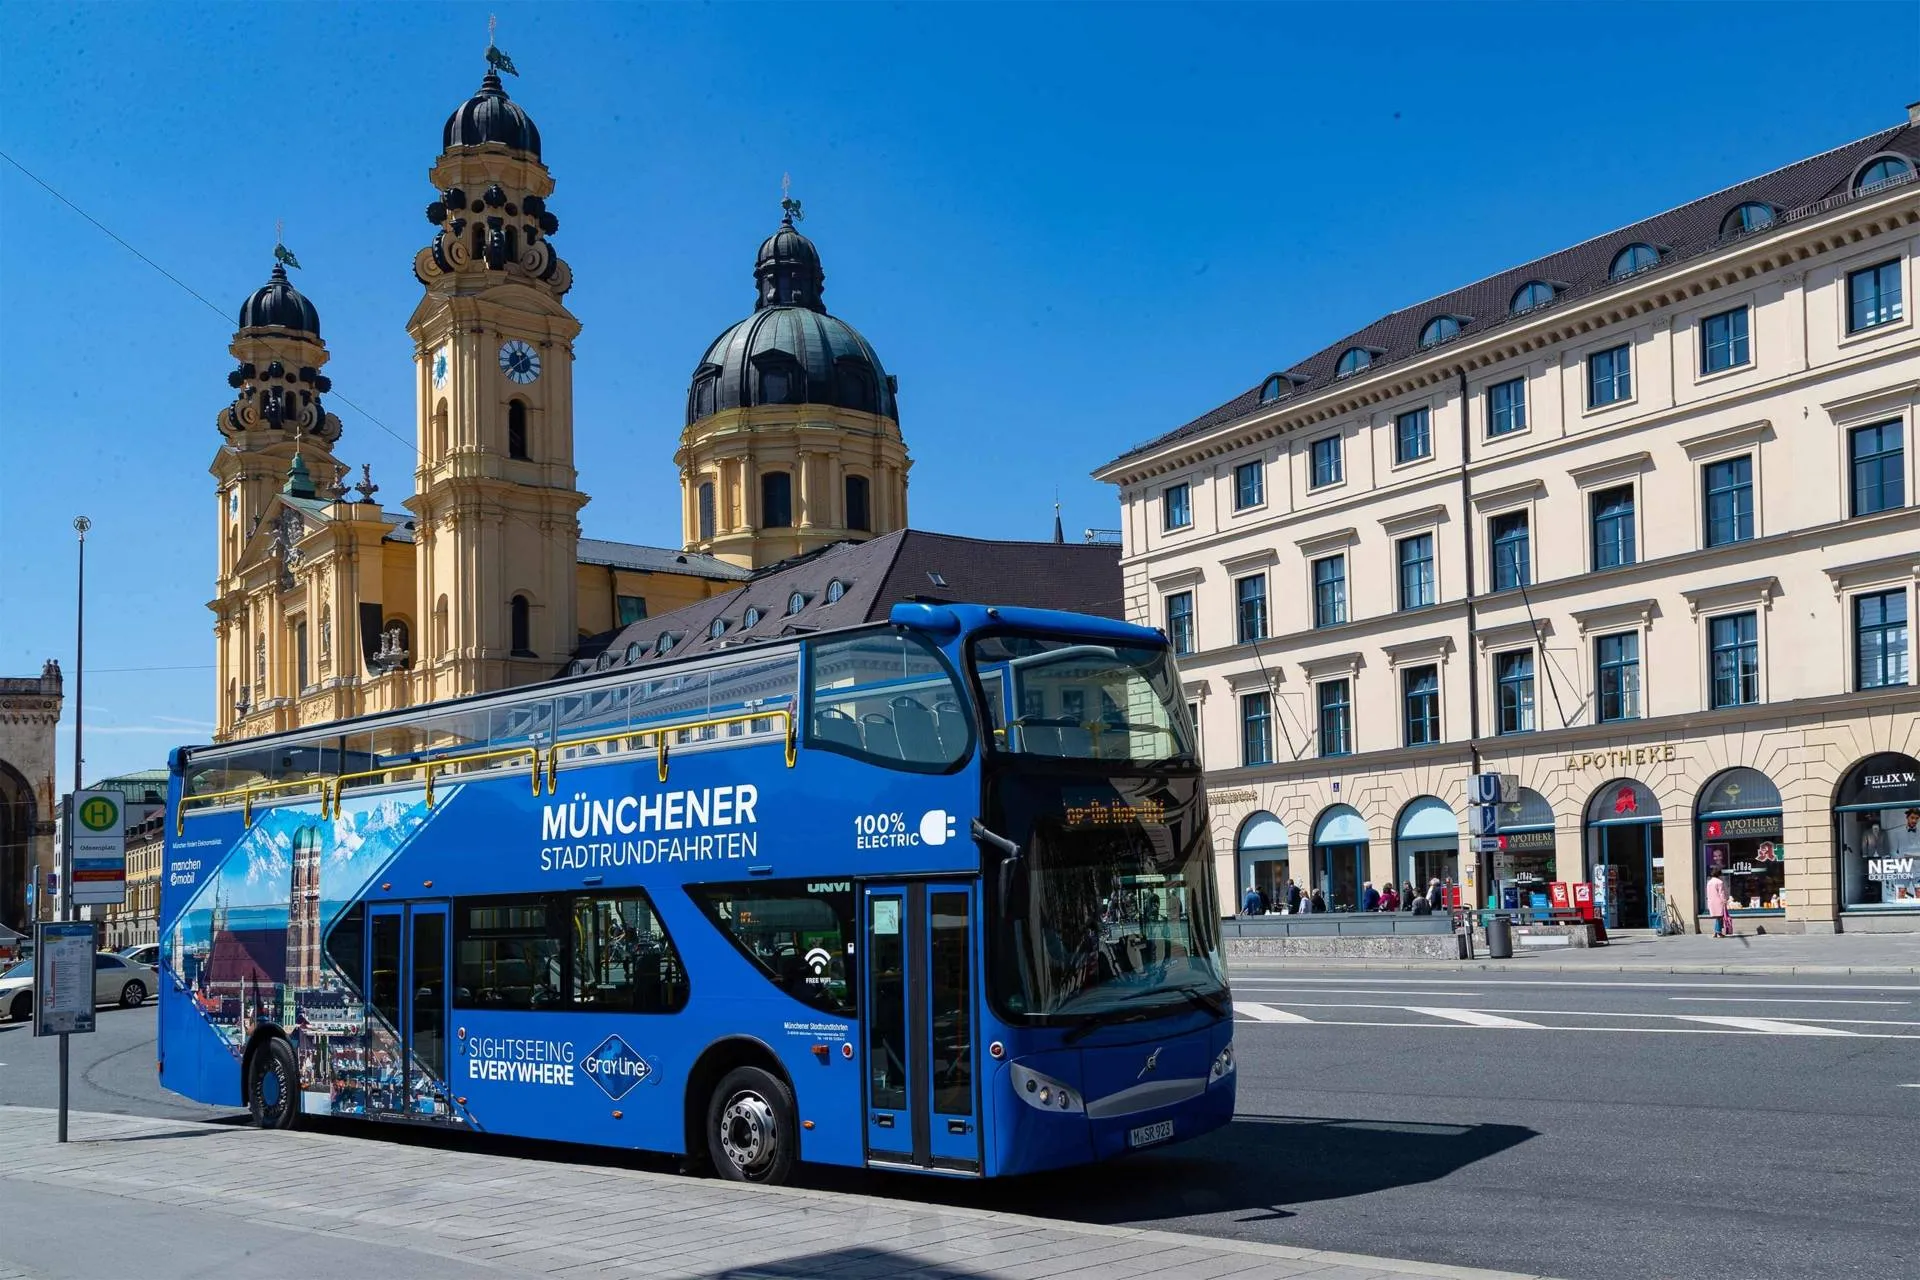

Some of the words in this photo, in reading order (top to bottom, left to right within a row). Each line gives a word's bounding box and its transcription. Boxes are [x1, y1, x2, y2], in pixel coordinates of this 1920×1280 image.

[1567, 744, 1676, 772] APOTHEKE
[1480, 775, 1496, 801] U
[1864, 773, 1900, 786] FELIX
[1902, 772, 1916, 782] W.
[90, 803, 108, 824] H
[541, 784, 759, 841] MÜNCHENER
[854, 812, 906, 835] 100%
[1724, 817, 1779, 830] APOTHEKE
[857, 832, 920, 849] ELECTRIC
[1509, 833, 1553, 843] APOTHEKE
[540, 831, 758, 871] STADTRUNDFAHRTEN
[1868, 858, 1913, 874] NEW
[807, 882, 850, 892] UNVI
[469, 1037, 574, 1063] SIGHTSEEING
[469, 1059, 574, 1086] EVERYWHERE
